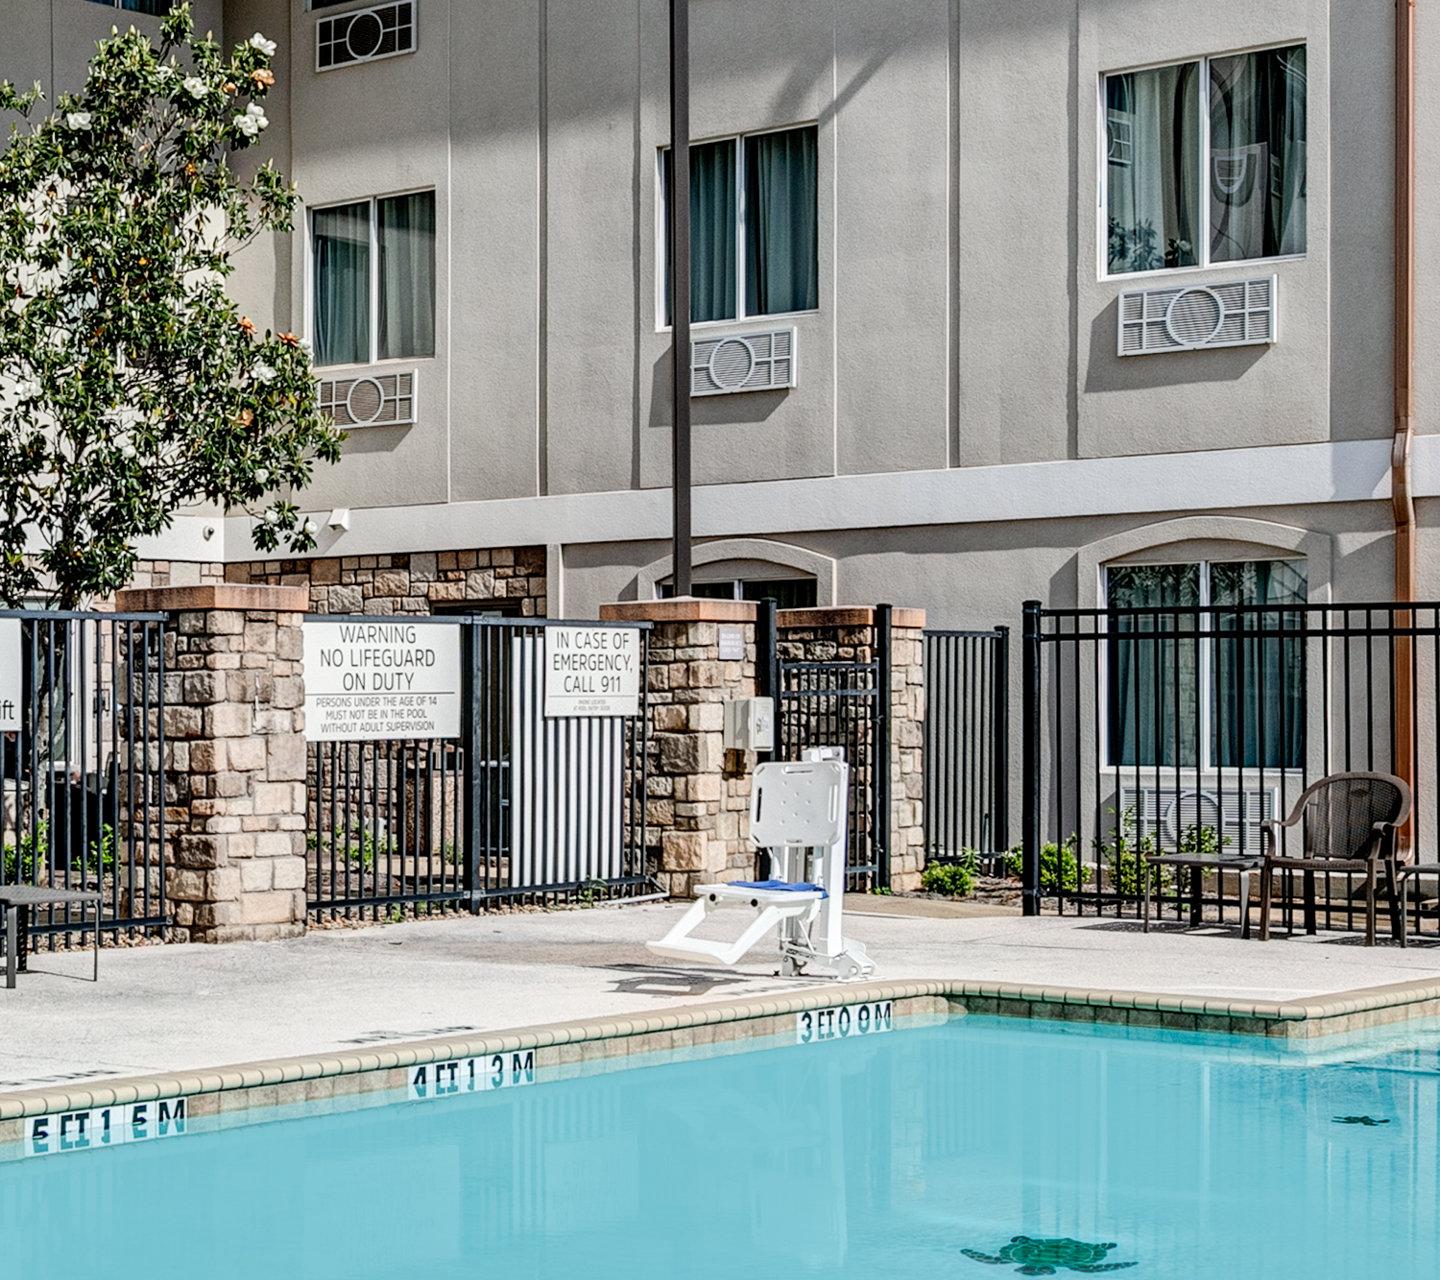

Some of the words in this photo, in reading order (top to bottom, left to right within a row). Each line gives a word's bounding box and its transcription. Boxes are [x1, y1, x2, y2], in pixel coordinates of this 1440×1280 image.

[339, 625, 416, 644] WARNING
[556, 631, 569, 648] IN
[575, 631, 607, 649] CASE
[612, 632, 629, 649] OF
[320, 648, 343, 668] NO
[350, 648, 435, 668] LIFEGUARD
[553, 653, 633, 673] EMERGENCY,
[342, 672, 366, 691] ON
[373, 672, 414, 691] DUTY
[563, 675, 595, 693] CALL
[601, 675, 621, 693] 911
[316, 696, 352, 708] PERSONS
[354, 696, 380, 708] UNDER
[383, 696, 397, 706] THE
[399, 696, 414, 707] AGE
[416, 695, 426, 706] OF
[428, 695, 437, 706] 14
[326, 709, 348, 721] MUST
[349, 709, 365, 720] NOT
[368, 709, 378, 720] BE
[380, 709, 388, 720] IN
[391, 709, 404, 720] THE
[407, 708, 427, 719] POOL
[320, 722, 357, 734] WITHOUT
[360, 721, 383, 733] ADULT
[386, 721, 435, 732] SUPERVISION
